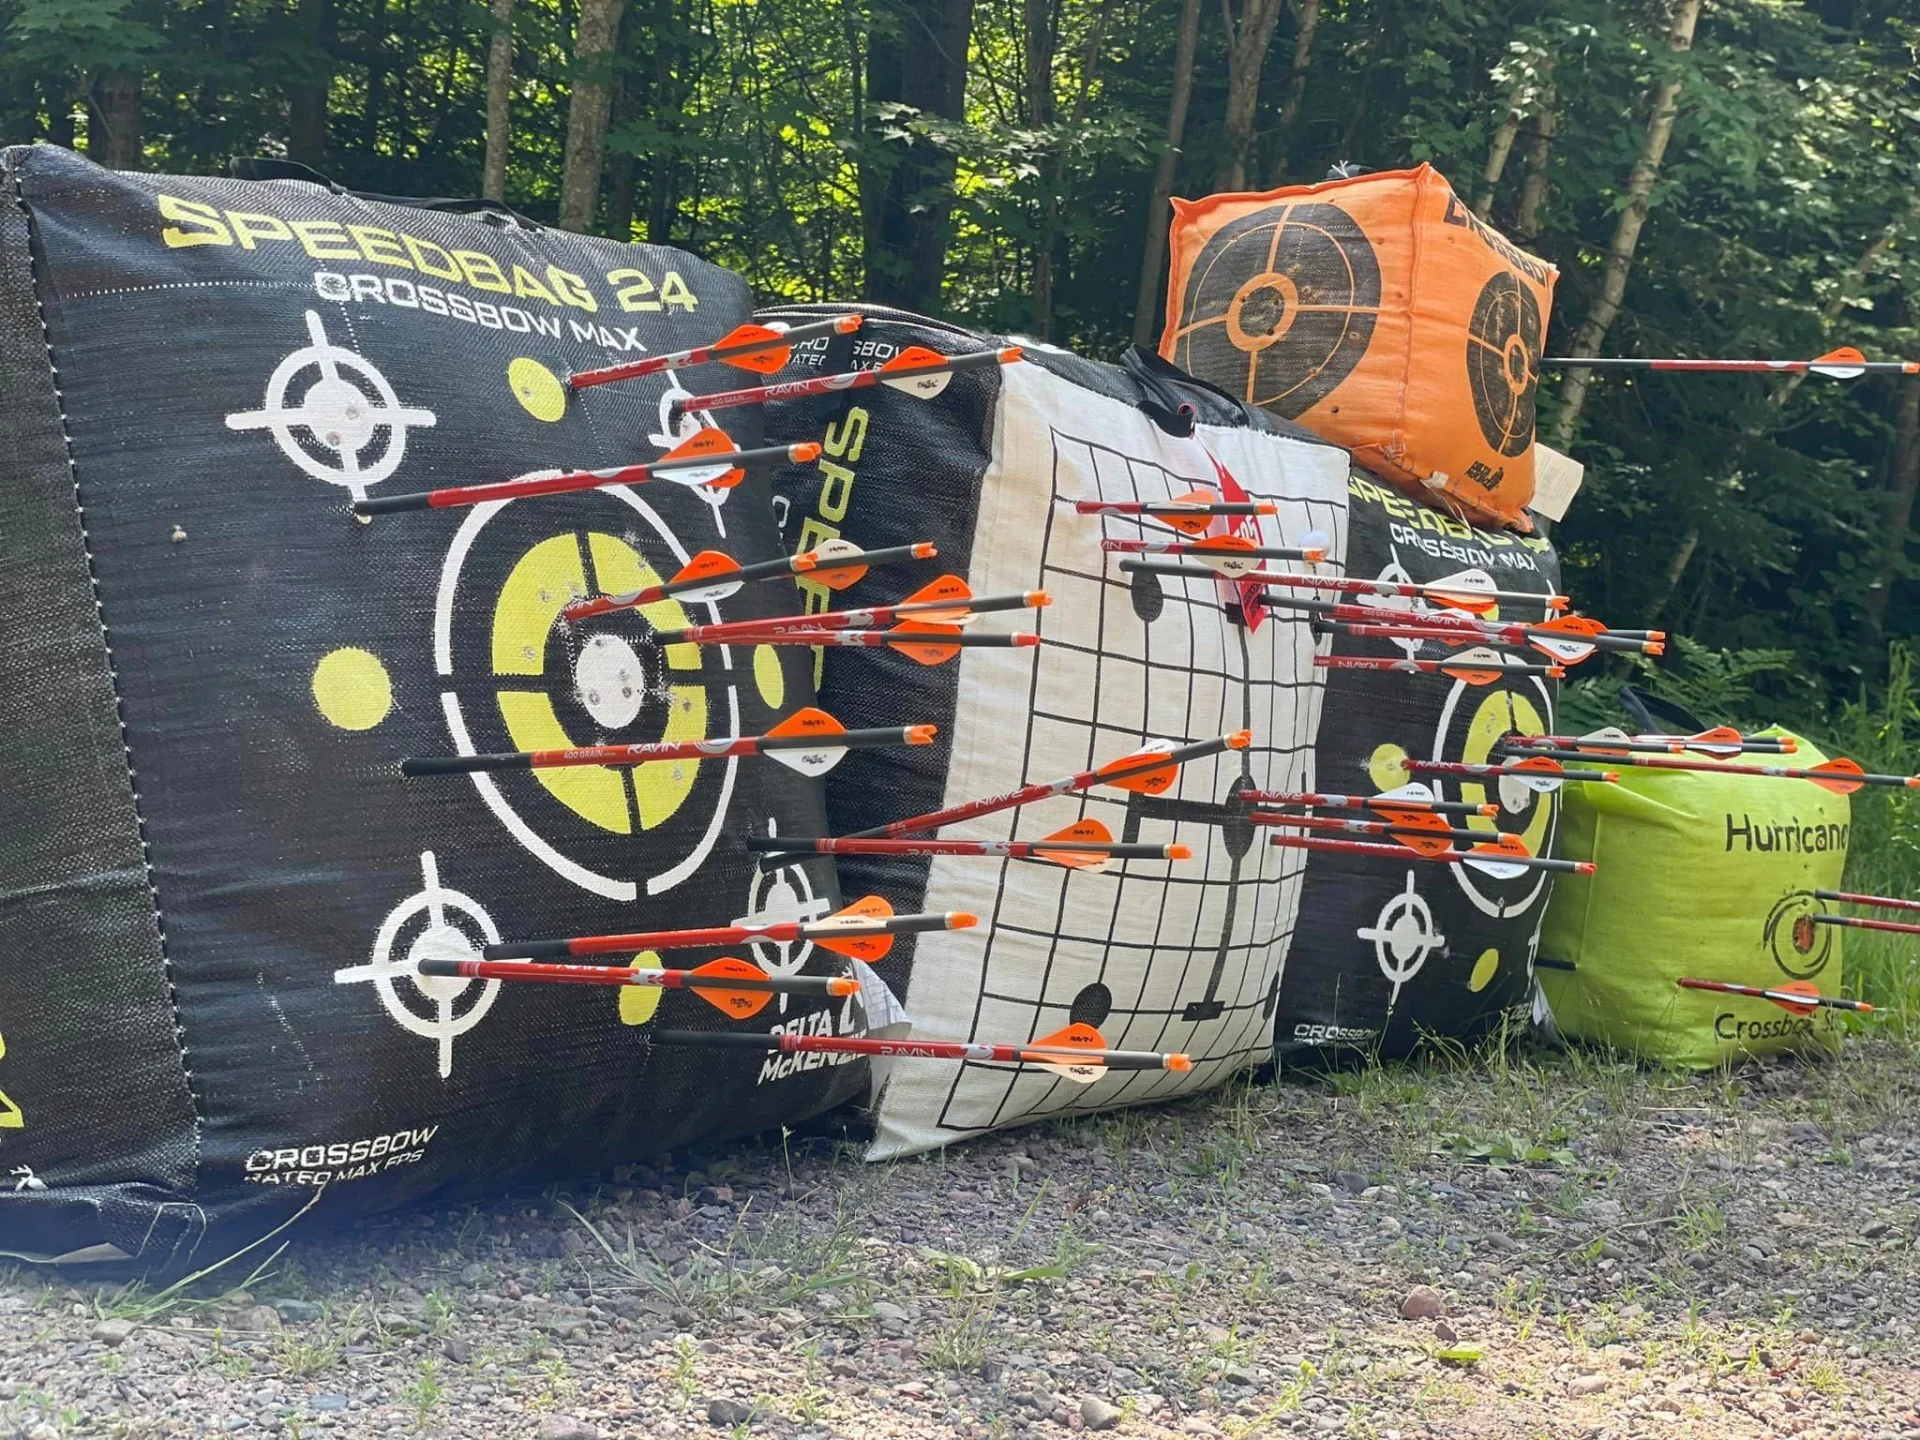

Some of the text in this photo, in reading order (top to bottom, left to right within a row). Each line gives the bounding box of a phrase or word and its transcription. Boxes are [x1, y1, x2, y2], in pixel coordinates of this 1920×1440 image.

[158, 194, 699, 313] SPEEDBAG 24
[314, 271, 648, 352] CROSSBOW MAX
[764, 381, 811, 398] RAVIN
[1499, 552, 1540, 573] MAX
[1414, 613, 1461, 626] RAVIN
[577, 749, 604, 759] GRAIN
[627, 740, 681, 756] RAVIN
[881, 1045, 936, 1058] RAVIN
[245, 1125, 439, 1172] CROSSBOW
[336, 1160, 383, 1182] MAX
[384, 1149, 425, 1171] FPS
